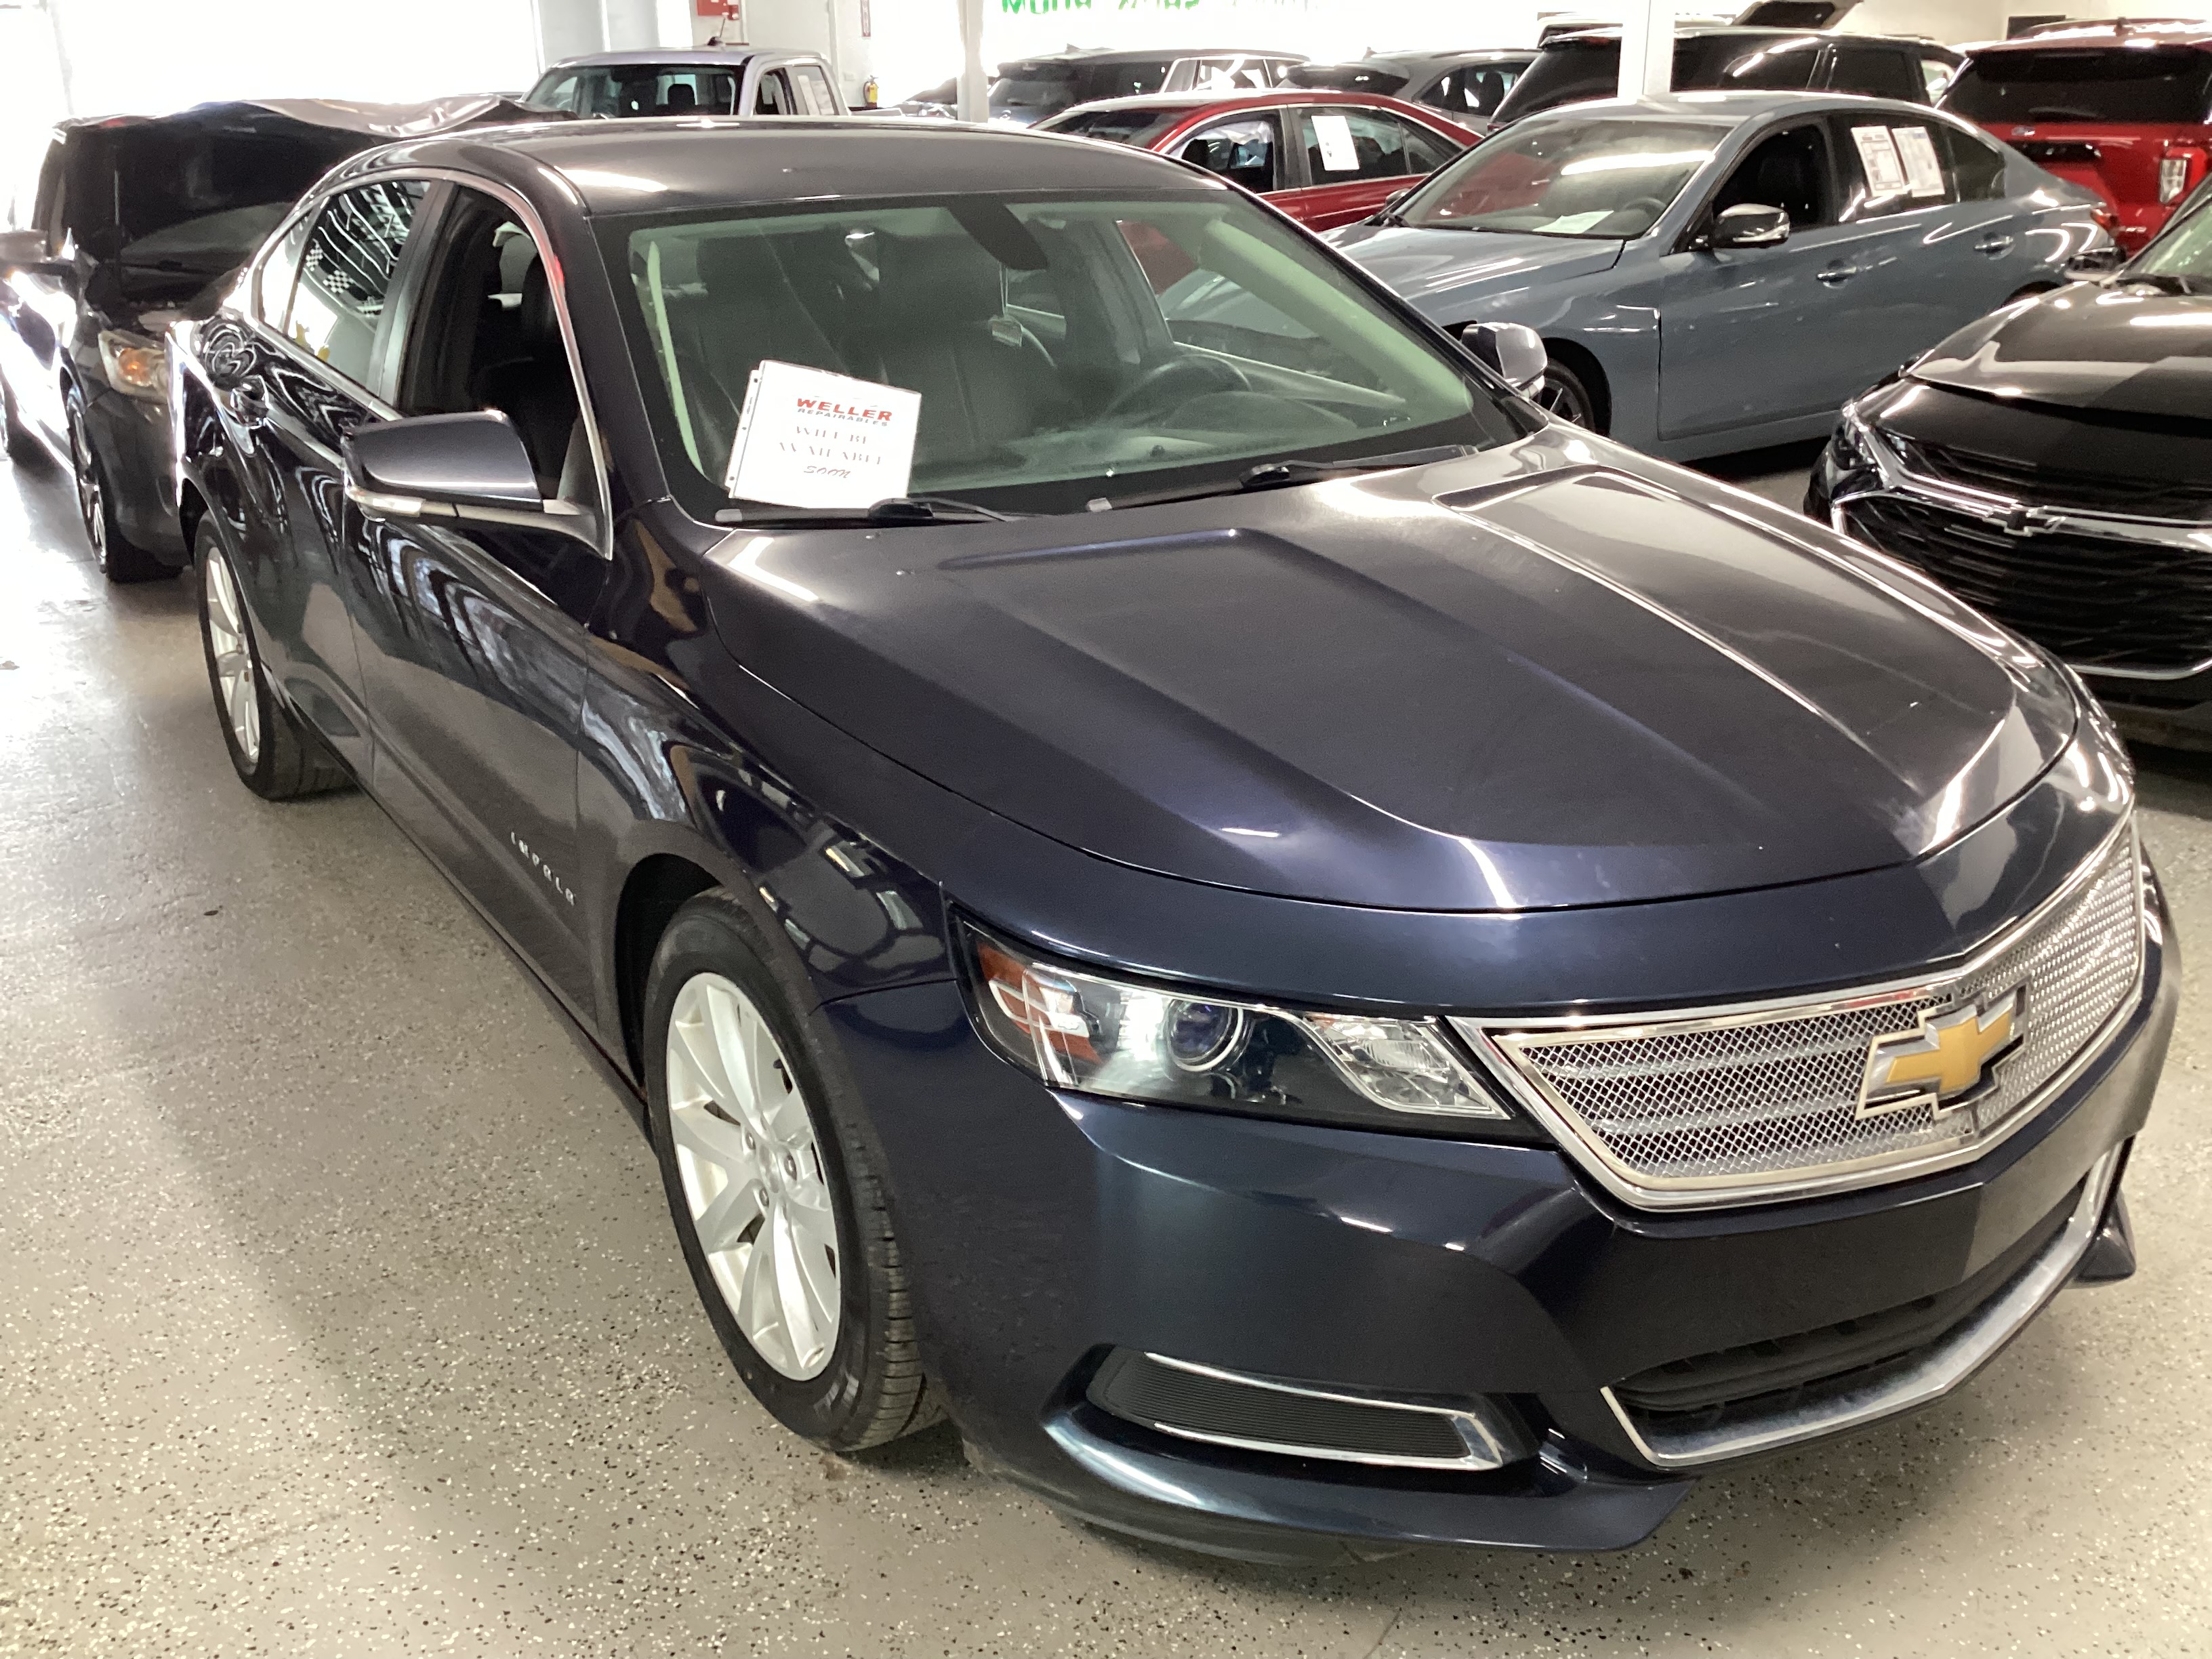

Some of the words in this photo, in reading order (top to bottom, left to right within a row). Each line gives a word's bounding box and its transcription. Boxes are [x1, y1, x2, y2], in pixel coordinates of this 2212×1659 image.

[797, 398, 893, 422] WELLER
[798, 408, 888, 427] REPAIRABLES
[510, 831, 575, 906] IMPALA
